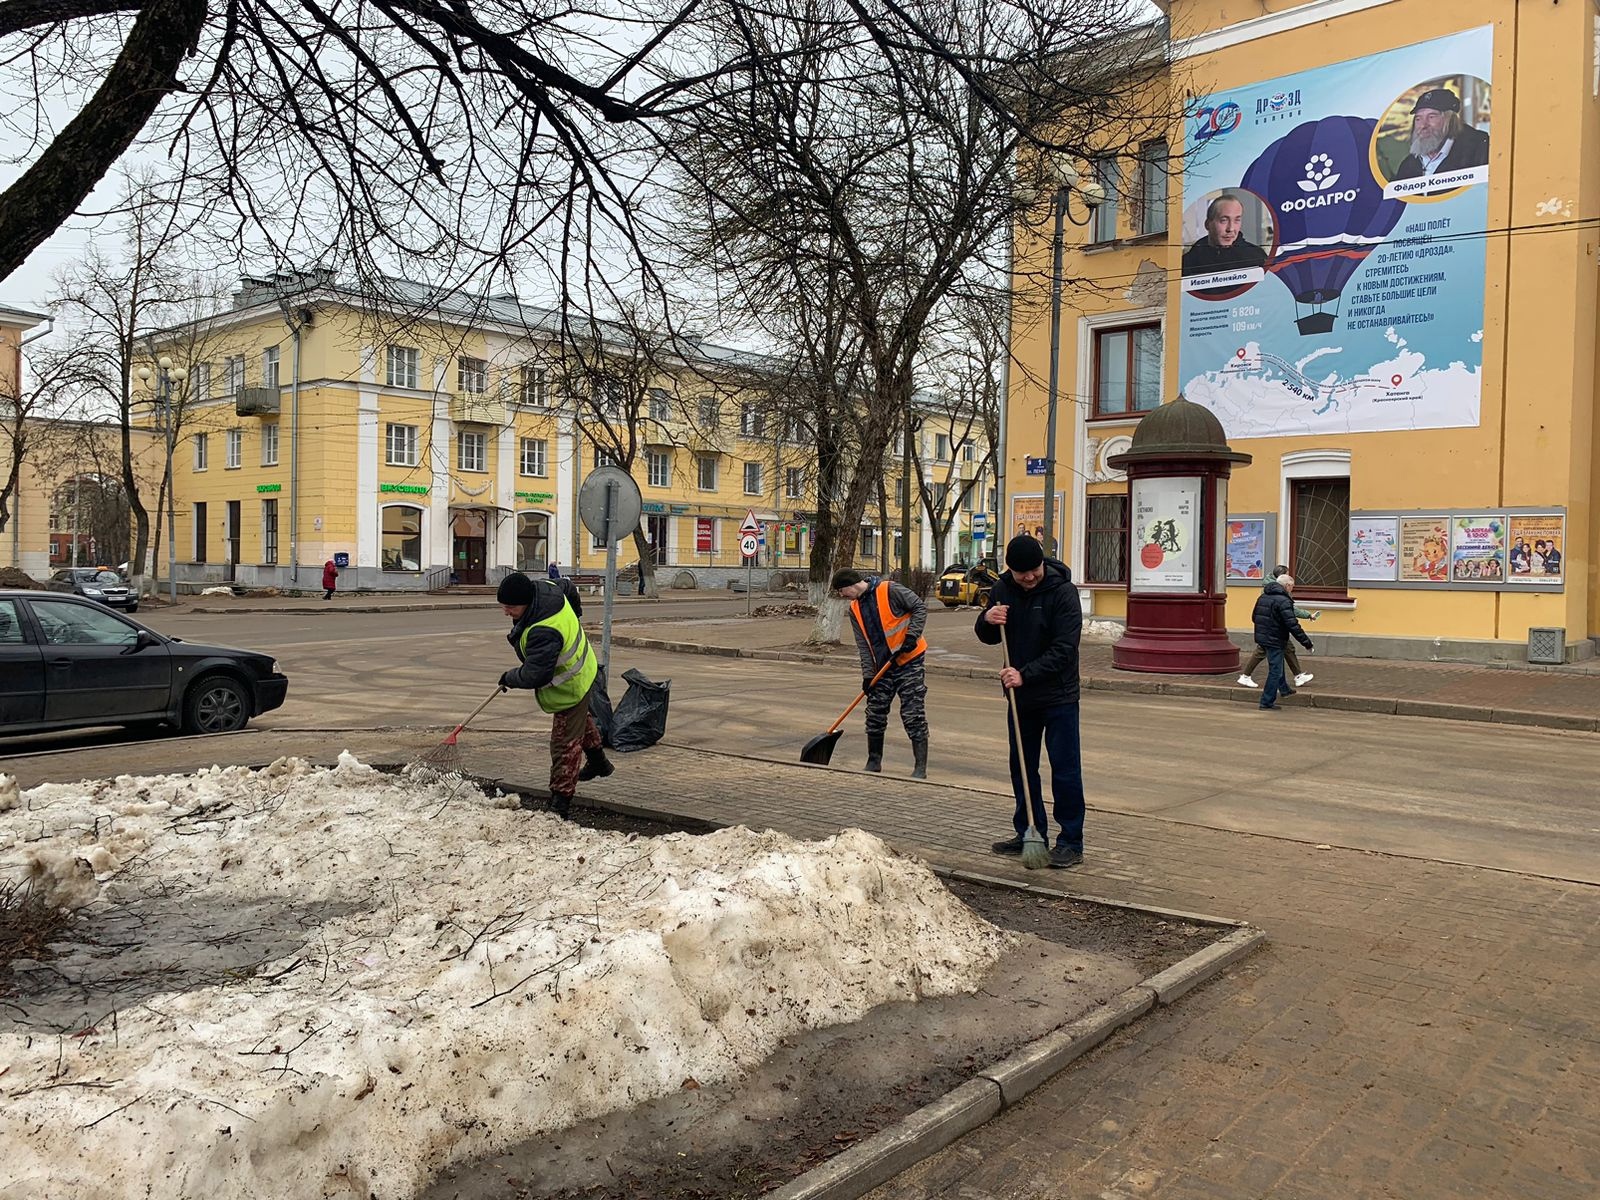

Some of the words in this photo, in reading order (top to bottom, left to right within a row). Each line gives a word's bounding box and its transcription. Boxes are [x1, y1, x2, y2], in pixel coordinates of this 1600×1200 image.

[1393, 180, 1427, 193] Фёдор
[1428, 172, 1474, 187] Конюхов
[1280, 189, 1357, 213] ФОСАГРО
[1427, 218, 1451, 231] ПОЛЁТ
[1377, 250, 1414, 264] 20-ЛЕТИЮ
[1365, 264, 1409, 278] СТРЕМИТЕСЬ
[1190, 278, 1211, 286] Иван
[1362, 279, 1389, 291] НОВЫМ
[1351, 292, 1380, 305] СТАВЬТЕ
[1381, 288, 1416, 301] БОЛЬШИЕ
[1416, 286, 1437, 298] ЦЕЛИ
[1353, 305, 1386, 317] НИКОГДА
[1232, 322, 1246, 332] 109
[1347, 320, 1356, 330] НЕ
[1286, 383, 1302, 396] 540
[743, 540, 755, 550] 40
